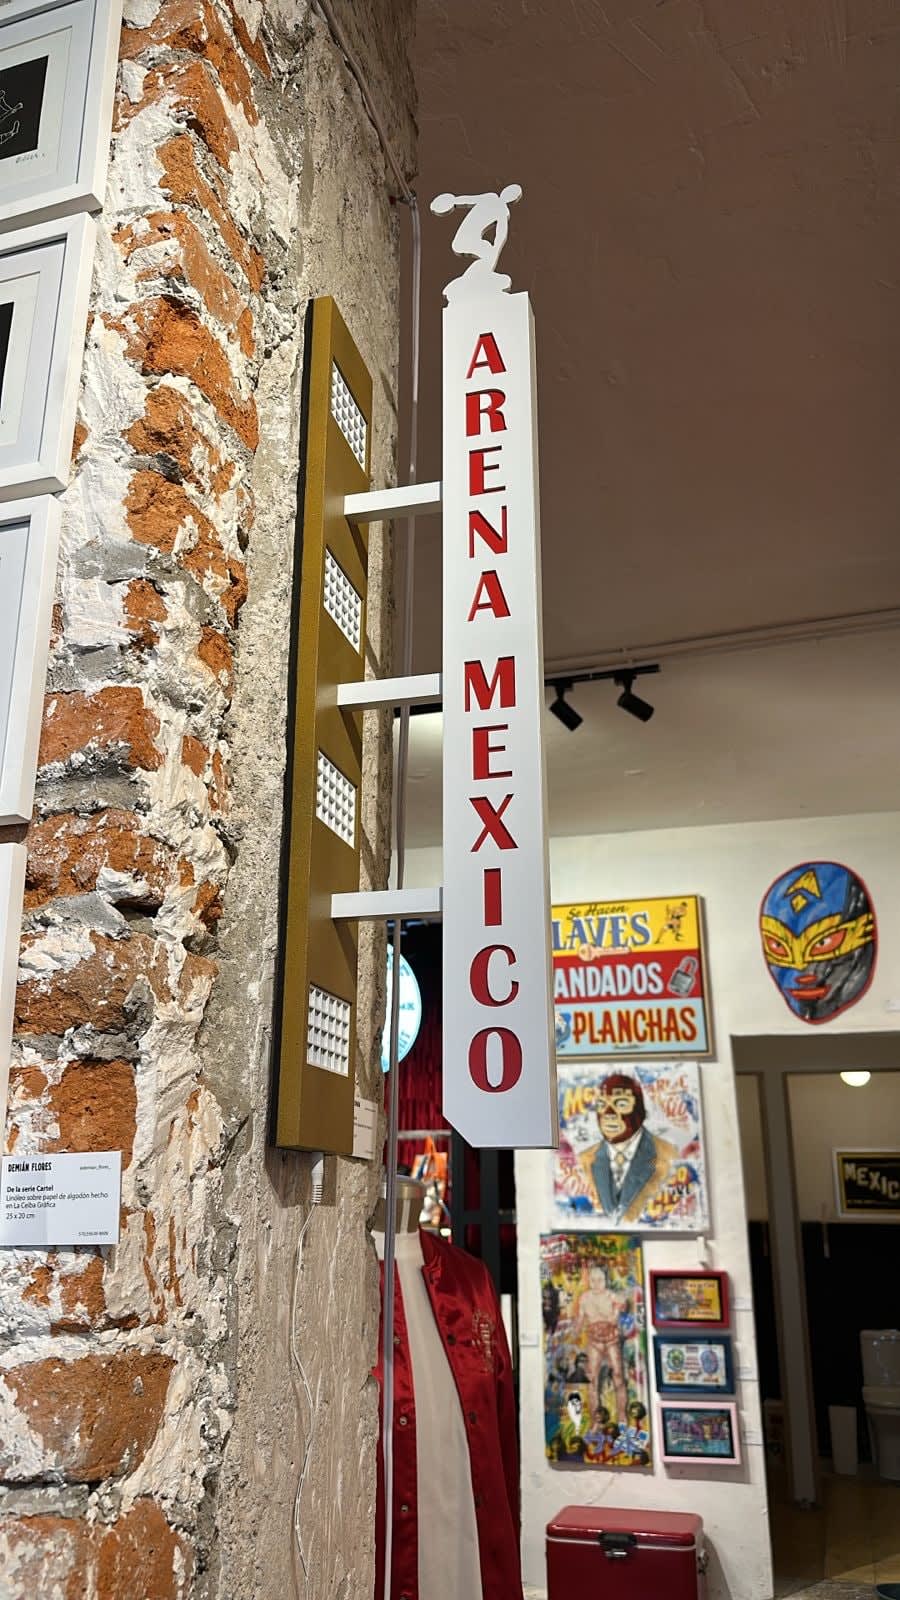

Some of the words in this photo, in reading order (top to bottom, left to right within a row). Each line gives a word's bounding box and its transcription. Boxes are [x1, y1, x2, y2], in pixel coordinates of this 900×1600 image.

[465, 331, 511, 622] ARENA
[464, 655, 523, 1093] MEXICO
[567, 907, 582, 920] Se
[554, 962, 664, 998] ANDADOS
[572, 1007, 698, 1044] PLANCHAS
[8, 1161, 30, 1172] DEMIÁN
[31, 1162, 52, 1172] FLORES
[844, 1162, 900, 1199] MEXIC
[21, 1201, 36, 1209] Ceiba
[27, 1193, 42, 1201] sobre
[42, 1193, 58, 1202] papel
[91, 1191, 109, 1199] hecho
